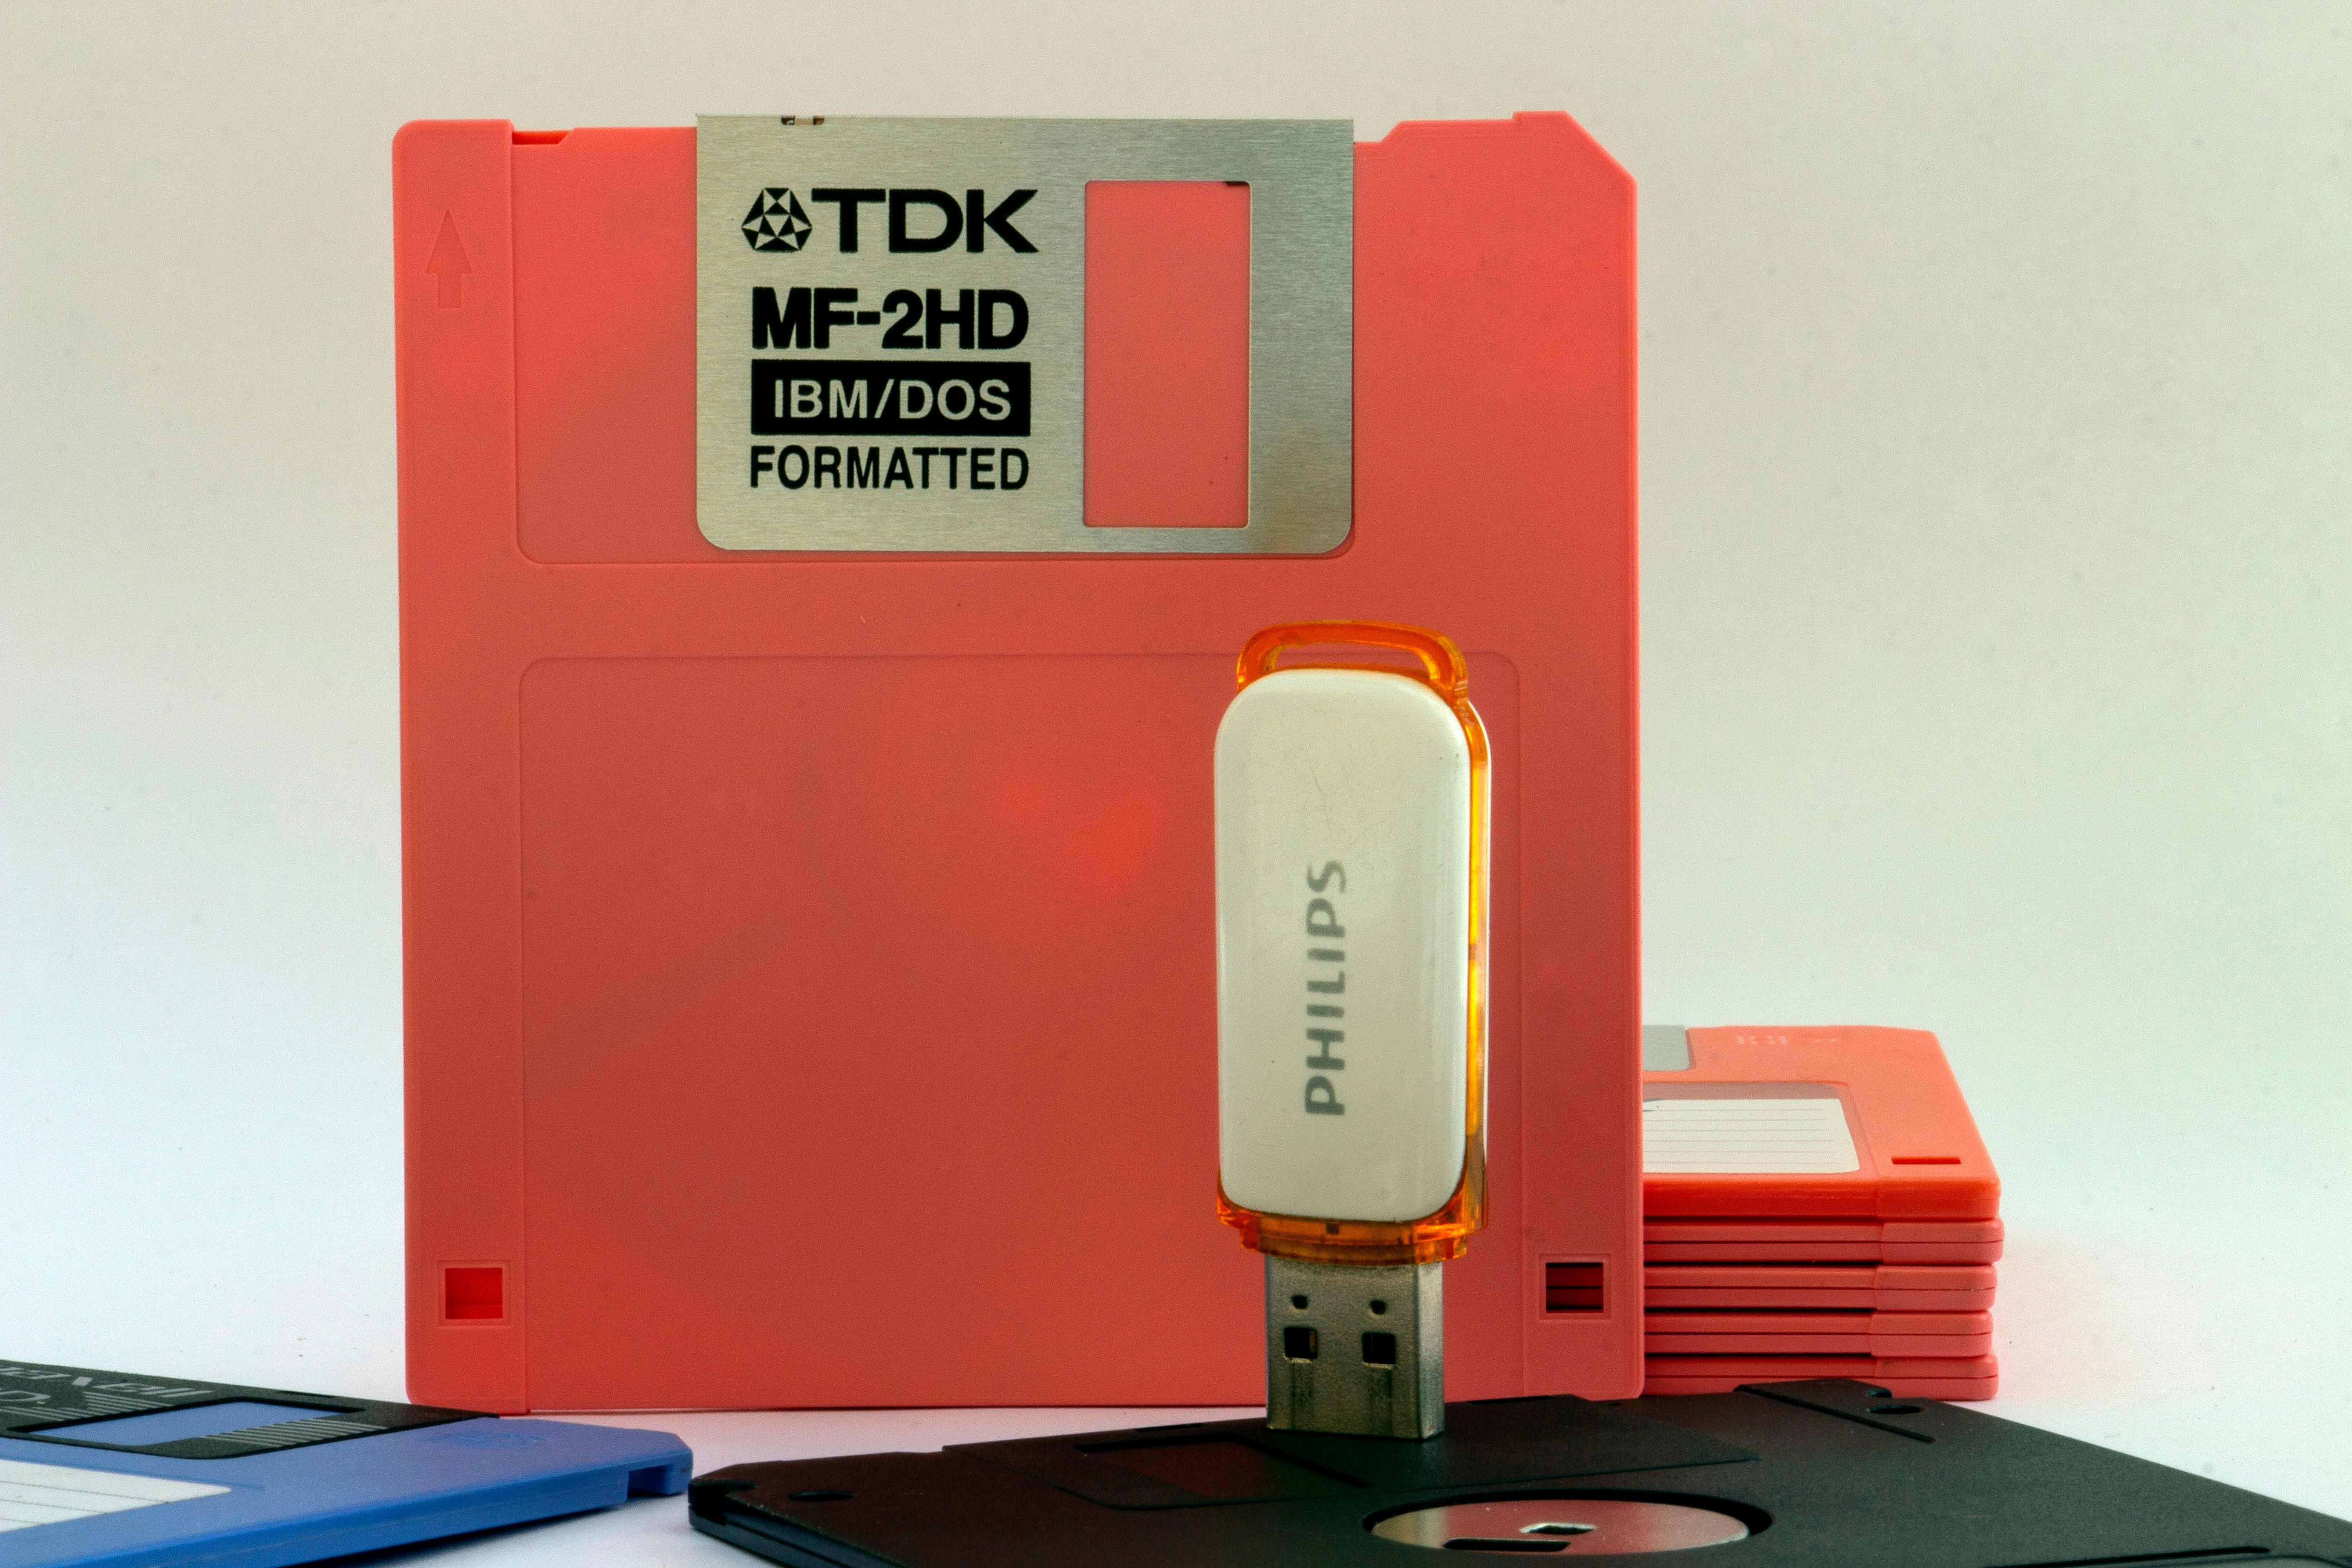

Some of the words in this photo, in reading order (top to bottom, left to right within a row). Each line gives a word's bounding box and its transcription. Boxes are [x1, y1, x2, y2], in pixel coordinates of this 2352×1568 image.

[811, 188, 1039, 254] TDK
[752, 286, 1030, 350] MF-2HD
[774, 378, 1011, 421] IBM/DOS
[750, 445, 1029, 490] FORMATTED
[1304, 861, 1346, 1116] PHILIPS
